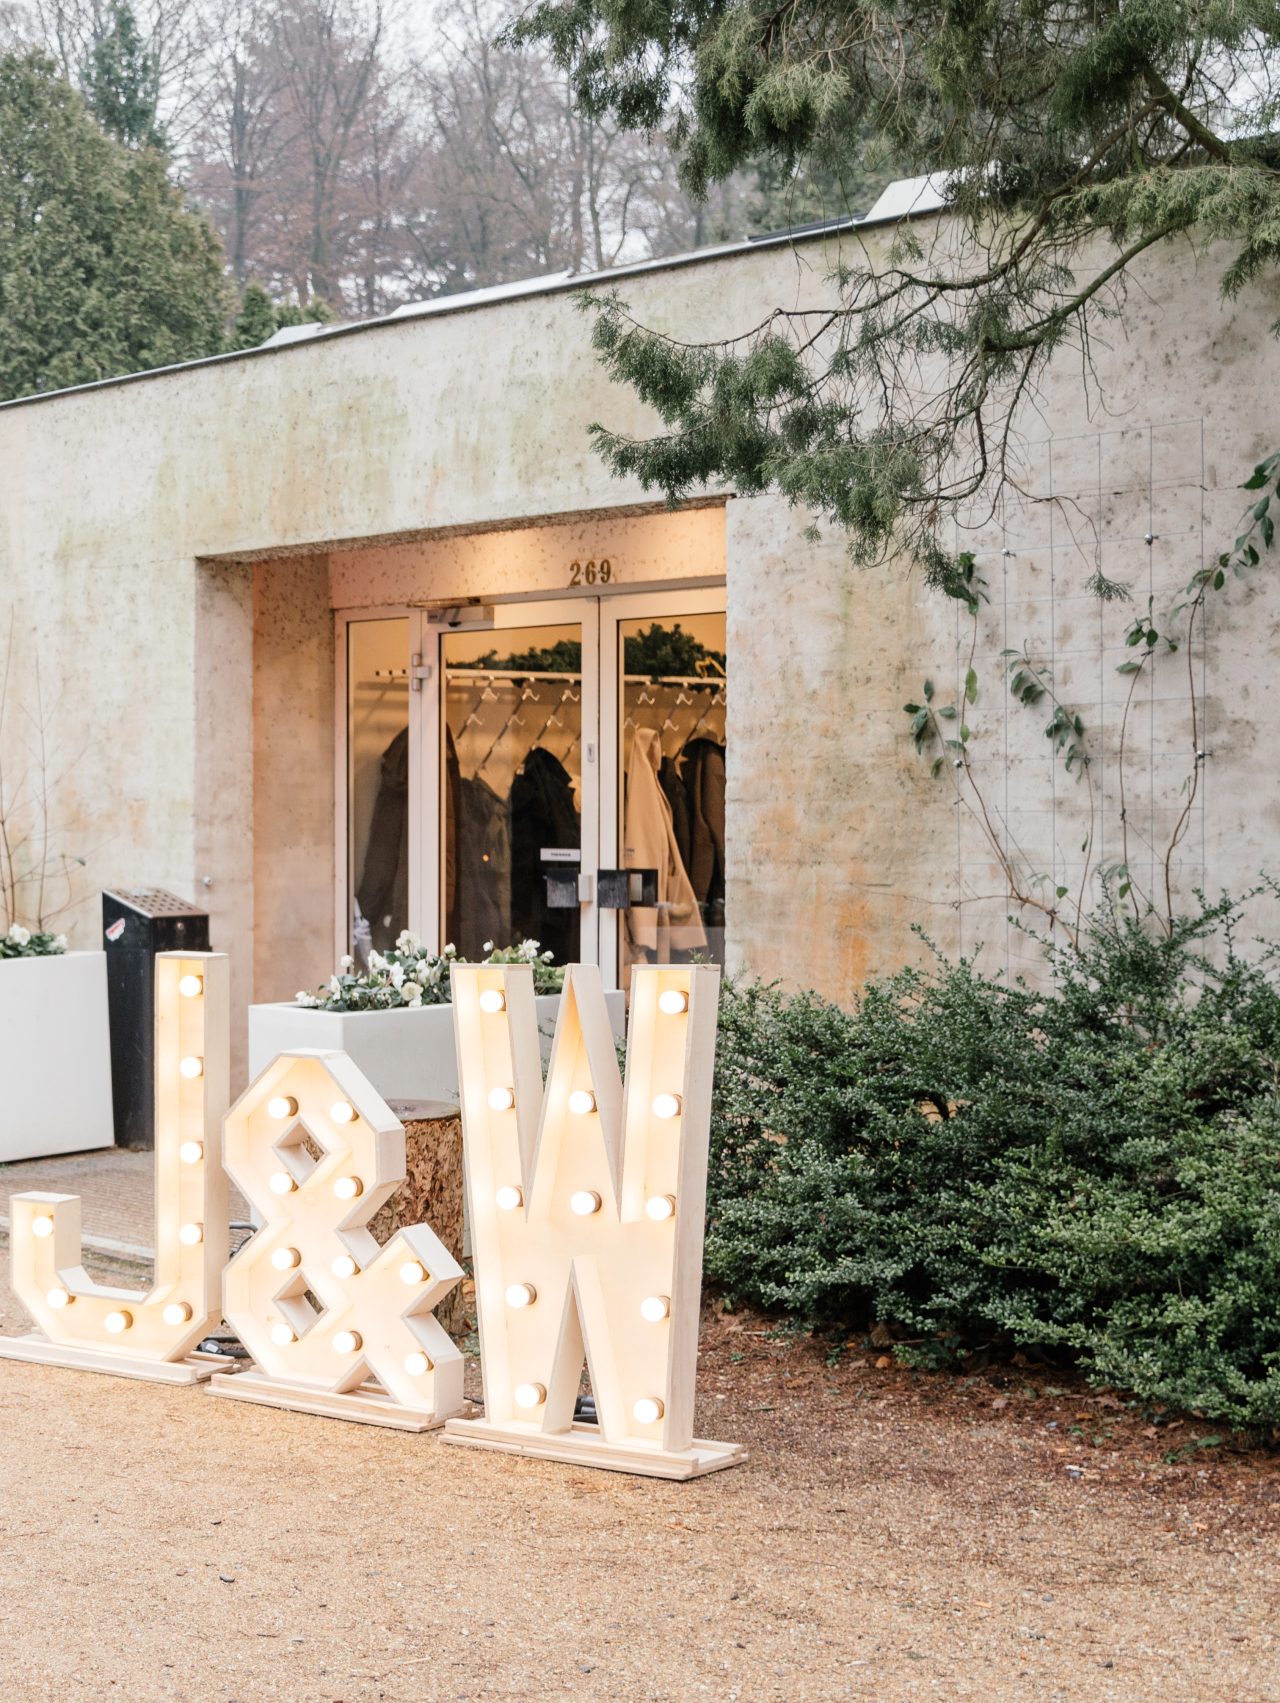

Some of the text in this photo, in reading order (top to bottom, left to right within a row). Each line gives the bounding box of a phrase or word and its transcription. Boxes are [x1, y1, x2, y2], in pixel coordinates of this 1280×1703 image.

[569, 559, 611, 587] 269
[10, 951, 231, 1363] J
[450, 963, 721, 1452] W
